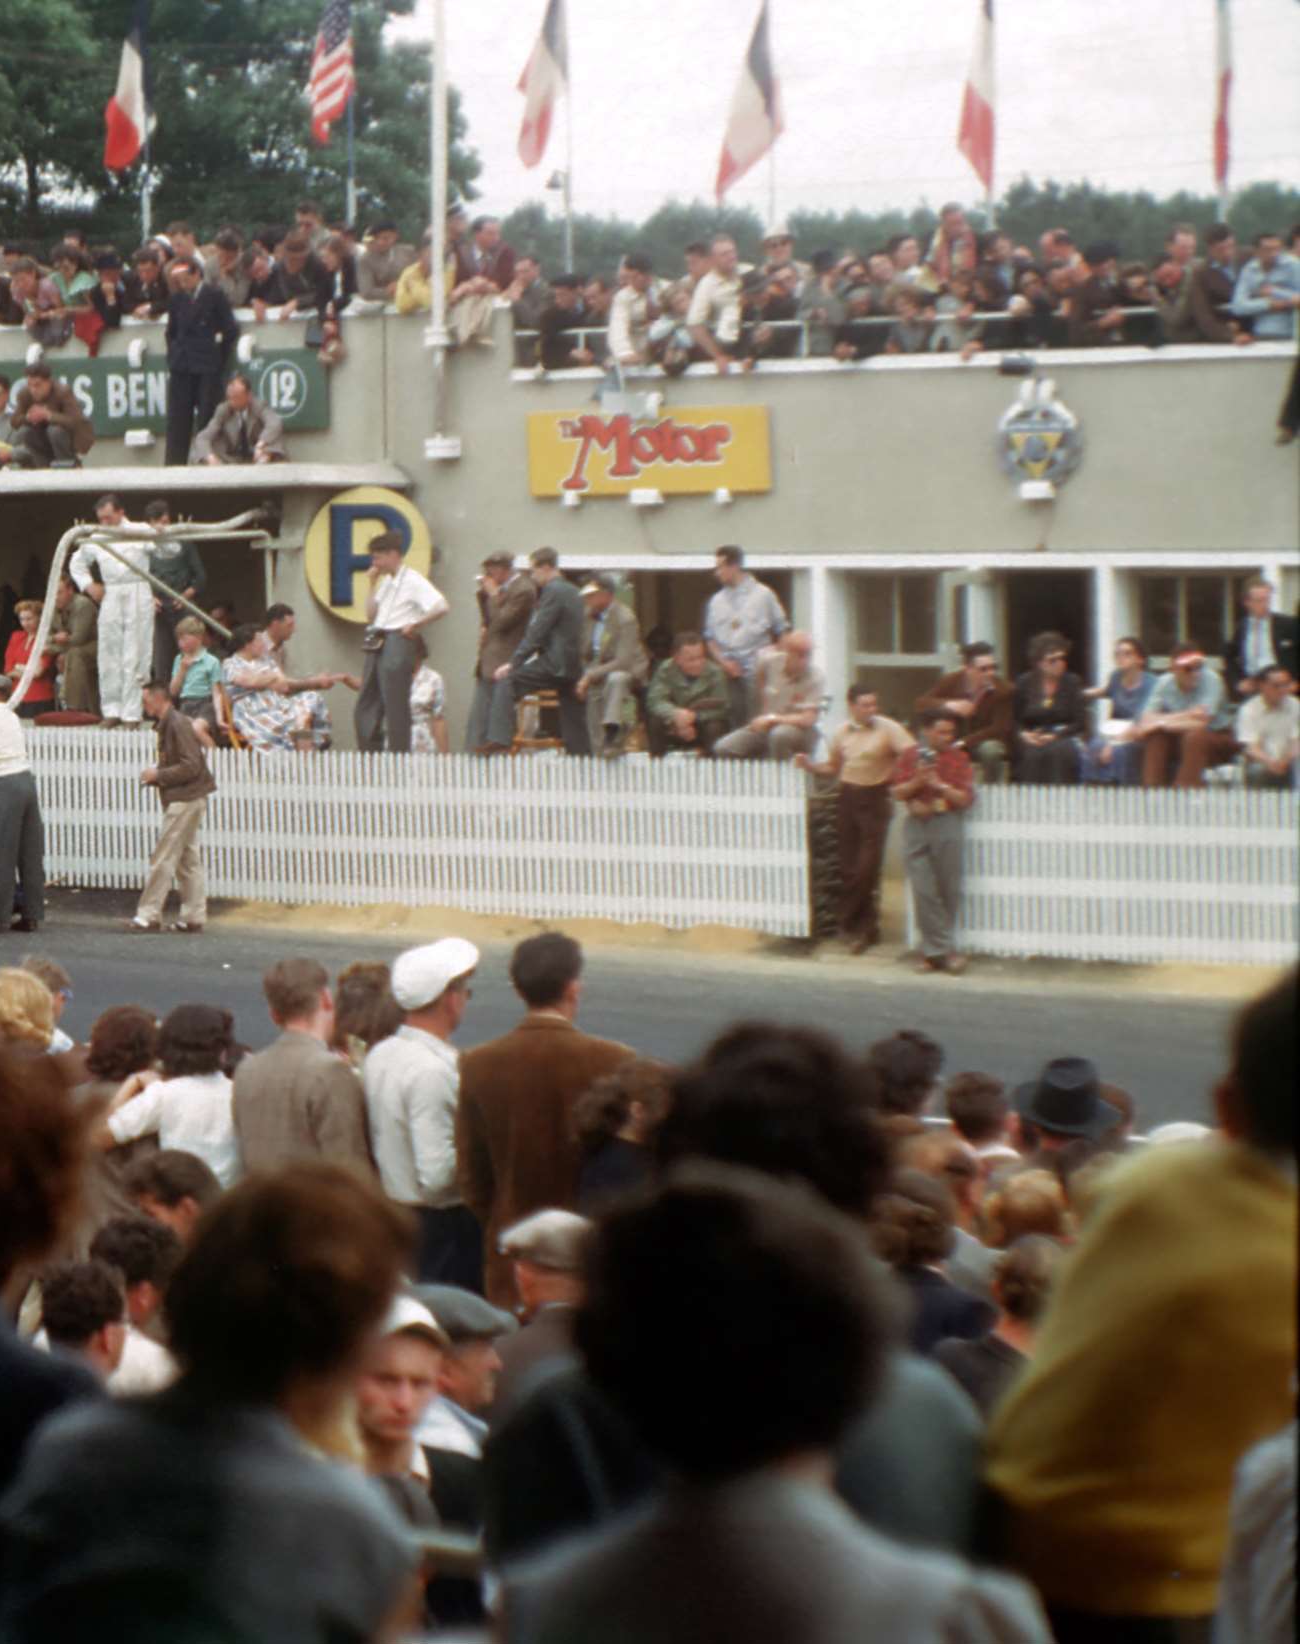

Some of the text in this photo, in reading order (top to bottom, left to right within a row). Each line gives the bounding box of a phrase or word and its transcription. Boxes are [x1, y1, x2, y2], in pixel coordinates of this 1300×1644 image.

[107, 371, 171, 419] BEN
[269, 368, 298, 409] 12
[561, 414, 731, 490] Motor
[329, 503, 413, 607] P
